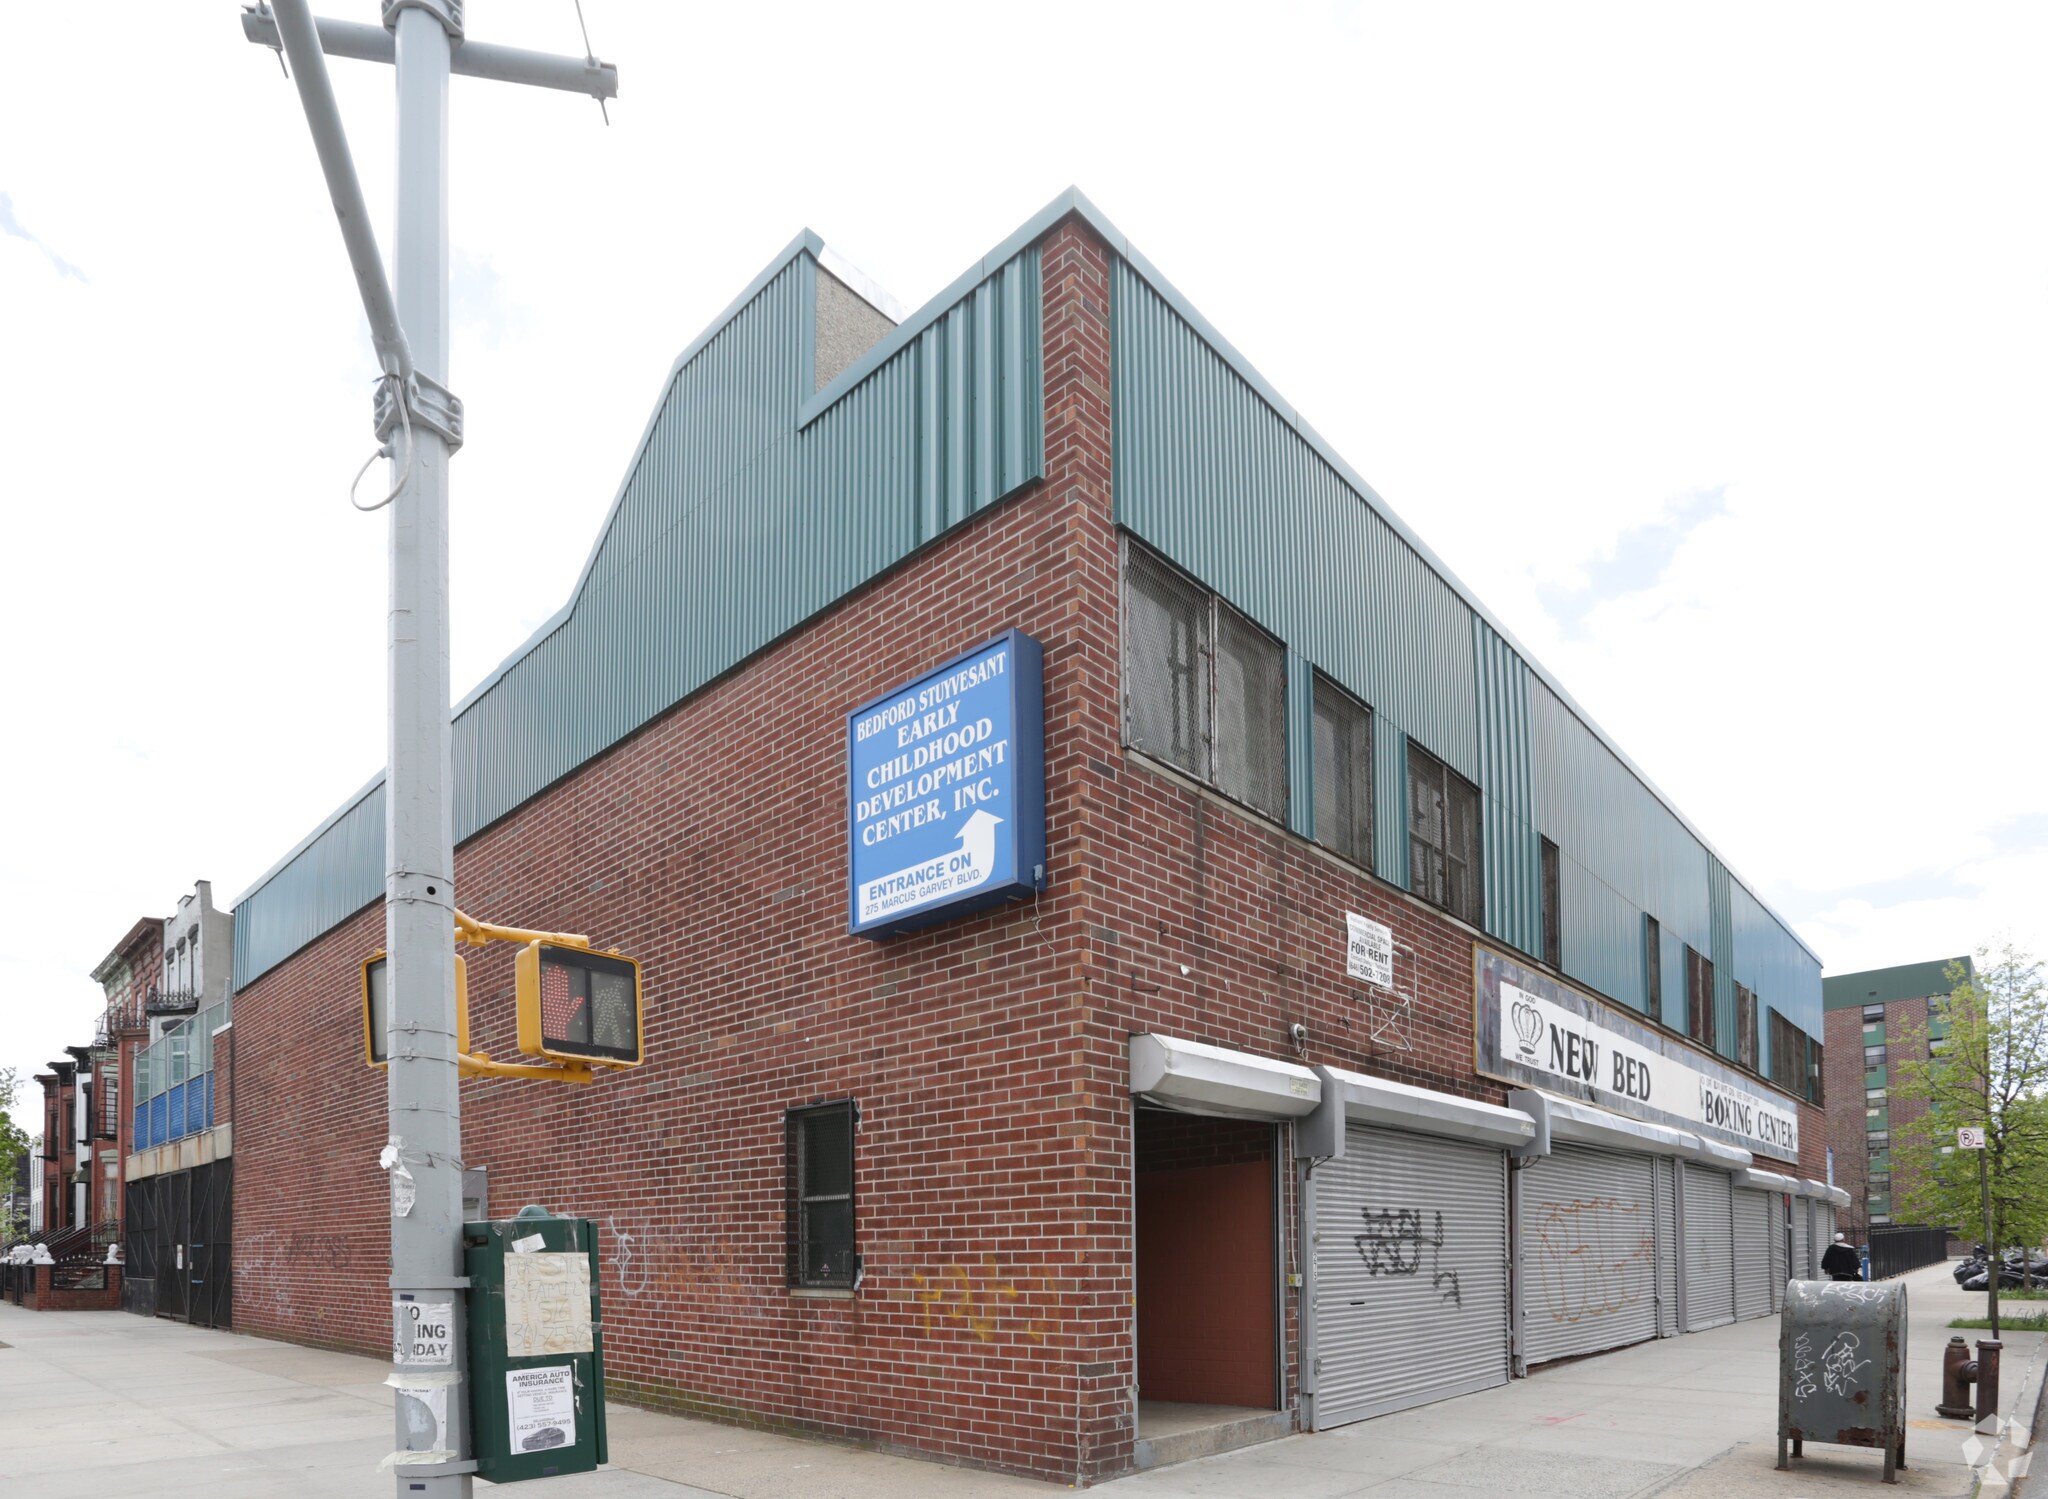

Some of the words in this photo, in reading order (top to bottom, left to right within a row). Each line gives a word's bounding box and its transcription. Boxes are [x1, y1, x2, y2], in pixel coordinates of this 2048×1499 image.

[857, 697, 916, 743] BEDFORD
[919, 652, 1007, 712] STUYVESANT
[897, 700, 961, 749] EARLY
[867, 718, 993, 789] CHILDHOOD
[857, 739, 1008, 823] DEVELOPMENT
[862, 798, 947, 846] CENTER,
[954, 776, 1000, 812] INC.
[865, 902, 879, 916] 275
[881, 890, 916, 910] MARCUS
[919, 877, 954, 897] GARVEY
[957, 868, 983, 886] BLVD.
[869, 861, 945, 900] ENTRANCE
[949, 852, 971, 873] ON
[1351, 941, 1366, 957] FOR
[1368, 948, 1389, 965] RENT
[1518, 991, 1524, 999] IN
[1525, 994, 1536, 1004] GOD
[1514, 1052, 1523, 1061] WE
[1524, 1055, 1539, 1067] TRUST
[1549, 1022, 1599, 1084] NEW
[1612, 1049, 1651, 1102] BED
[1705, 1089, 1752, 1136] BOXING
[1758, 1110, 1794, 1150] CENTER
[507, 1279, 525, 1302] 3
[512, 1373, 548, 1382] AMERICA
[550, 1370, 570, 1378] AUTO
[519, 1377, 565, 1388] INSURANCE
